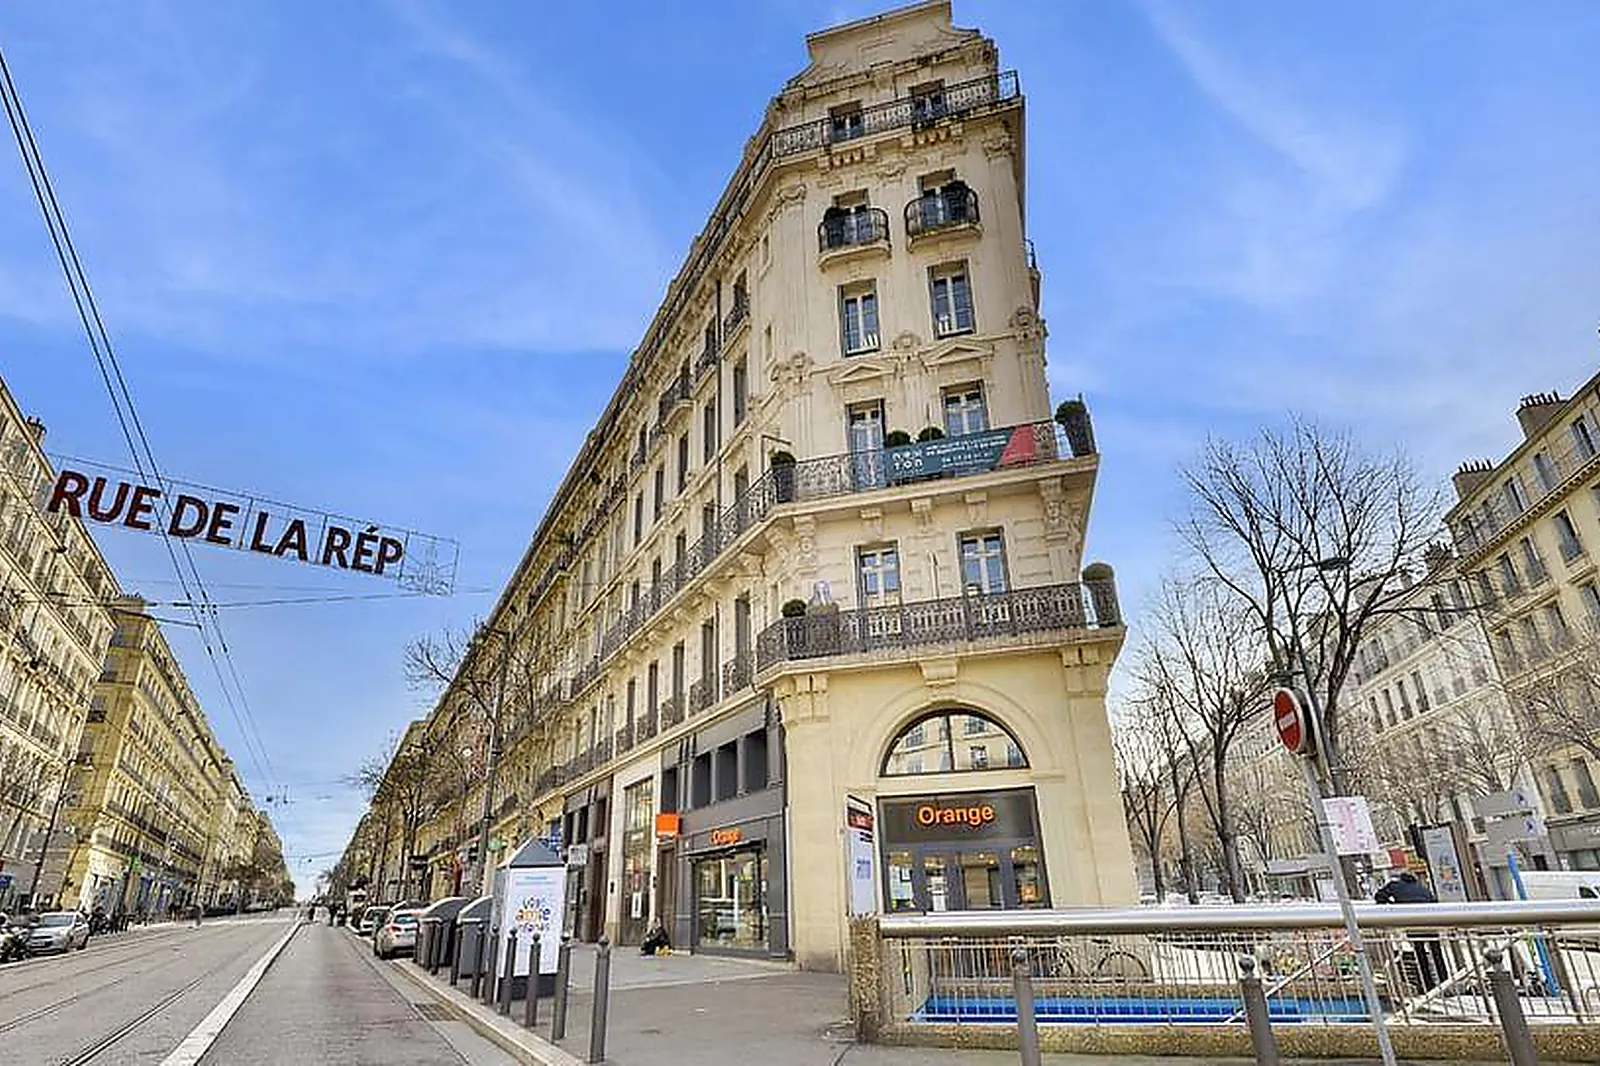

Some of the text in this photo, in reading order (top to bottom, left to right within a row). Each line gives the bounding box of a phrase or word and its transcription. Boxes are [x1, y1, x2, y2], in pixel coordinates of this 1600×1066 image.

[48, 470, 403, 575] RUE DE LA RÉP
[918, 805, 995, 826] Orange
